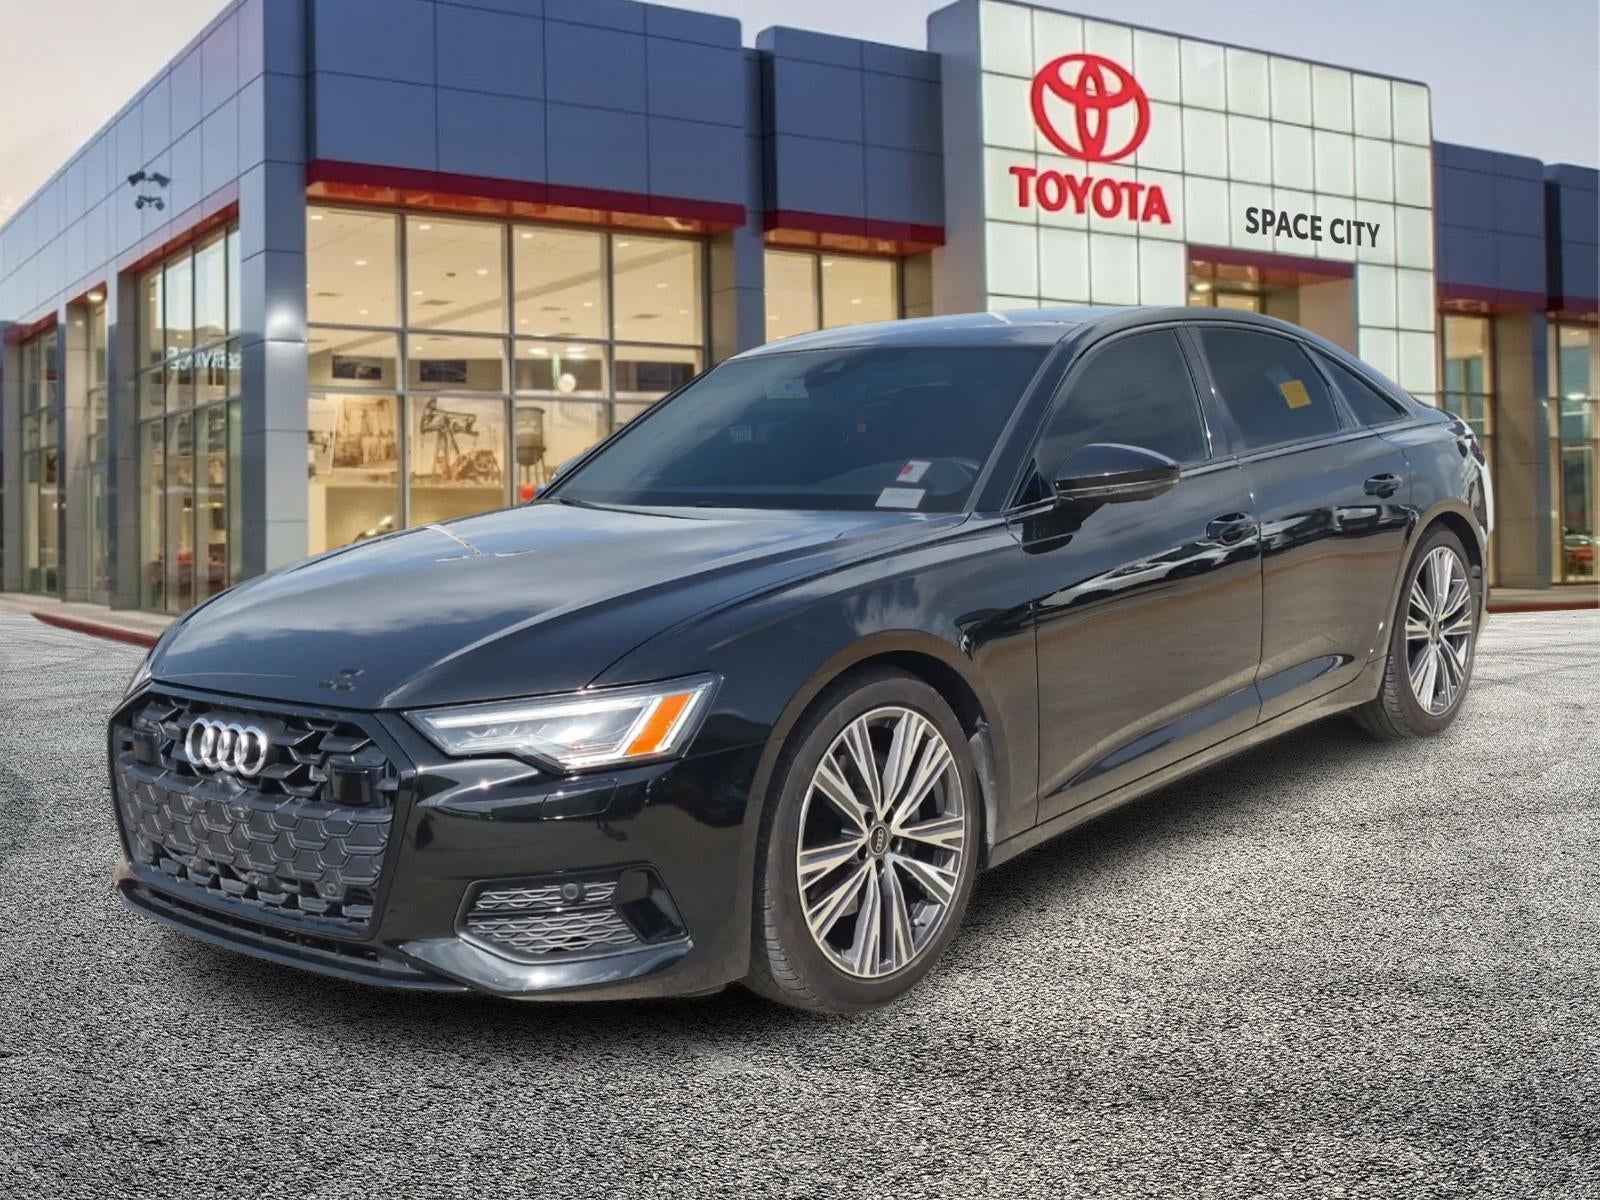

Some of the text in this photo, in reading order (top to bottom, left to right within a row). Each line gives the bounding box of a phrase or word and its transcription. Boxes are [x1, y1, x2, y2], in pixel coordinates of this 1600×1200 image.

[1009, 166, 1172, 225] TOYOTA
[1245, 206, 1381, 248] SPACE CITY
